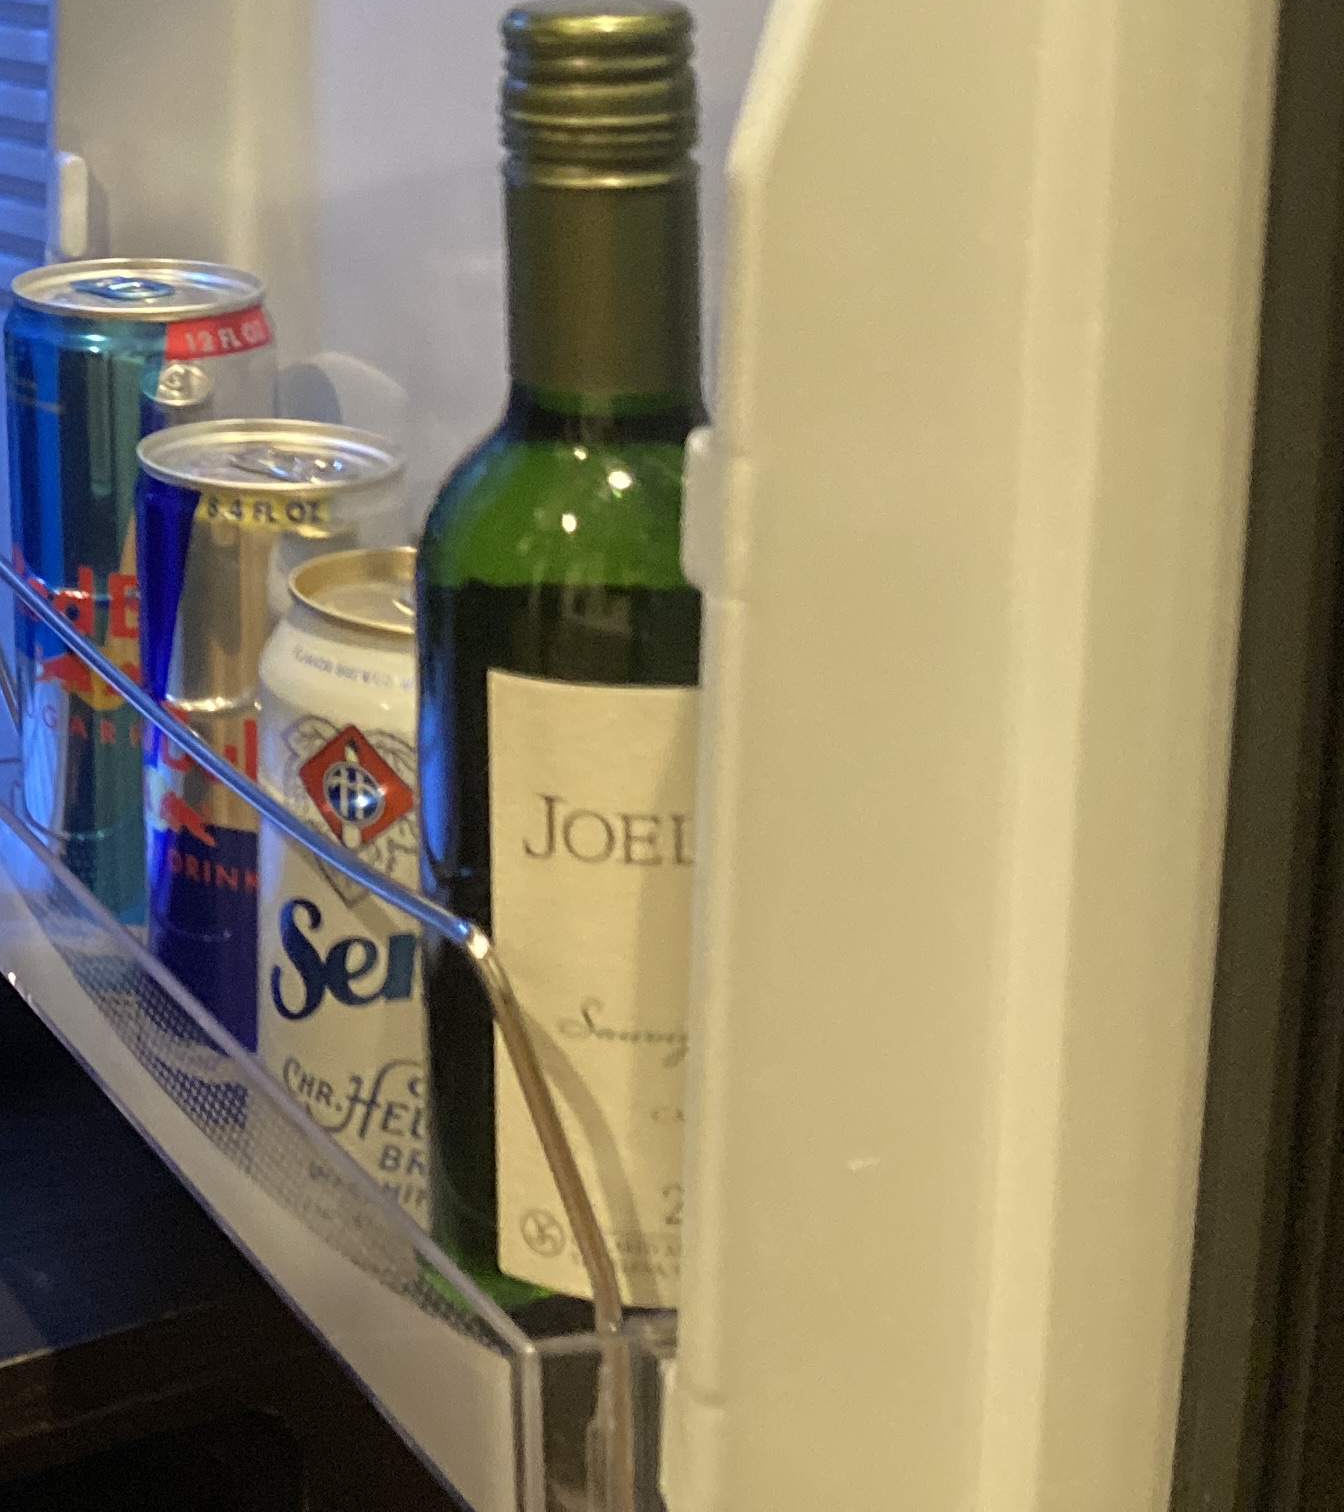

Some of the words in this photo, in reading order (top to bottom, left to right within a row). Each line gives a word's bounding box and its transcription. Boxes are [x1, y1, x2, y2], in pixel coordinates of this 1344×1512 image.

[185, 330, 215, 354] 12
[217, 327, 242, 349] FL
[253, 500, 277, 523] FL
[285, 499, 323, 523] OZ
